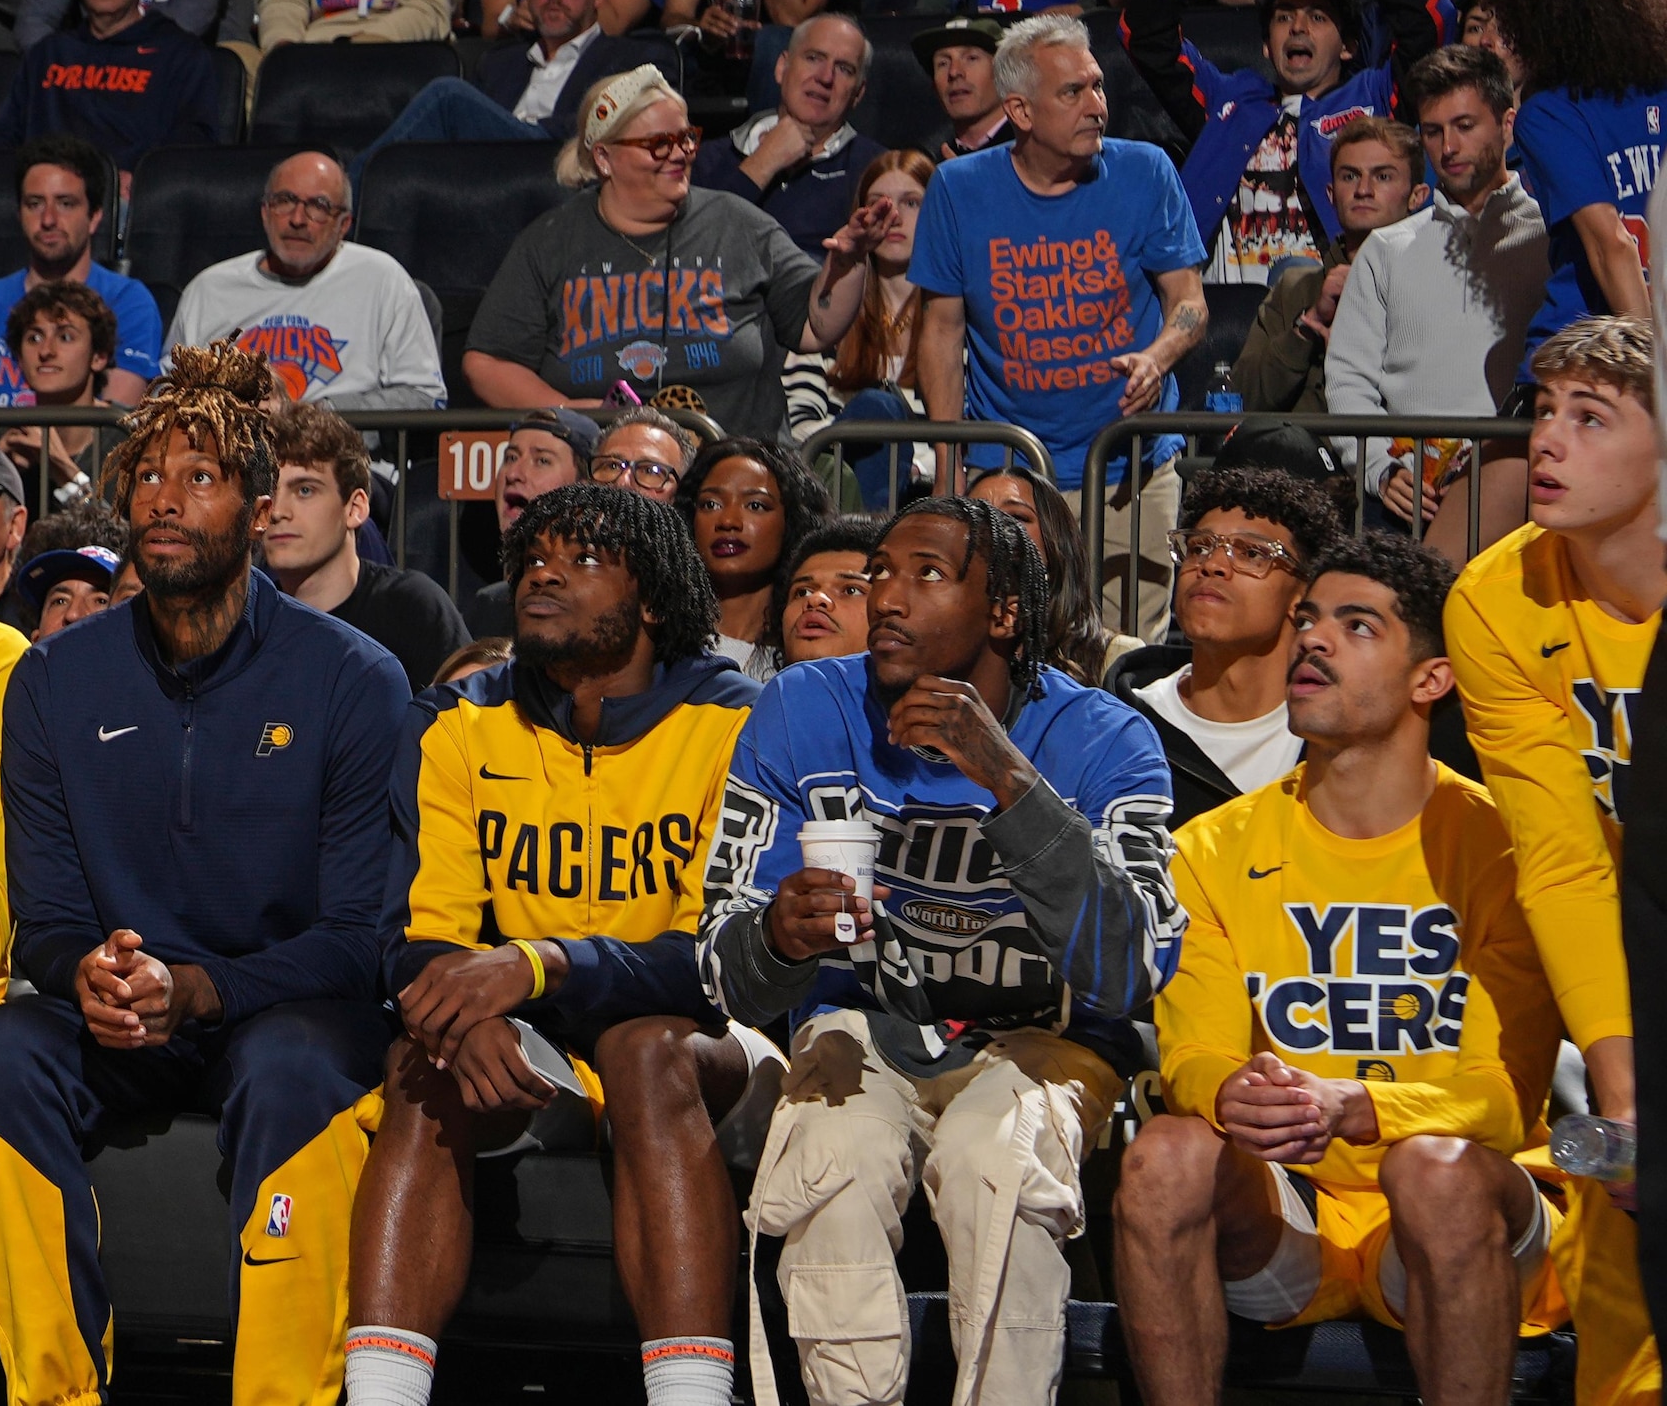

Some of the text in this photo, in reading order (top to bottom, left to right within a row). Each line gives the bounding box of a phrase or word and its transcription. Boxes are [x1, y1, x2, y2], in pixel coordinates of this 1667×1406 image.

[1607, 145, 1660, 201] EWI
[989, 230, 1119, 271] Ewing&
[990, 258, 1127, 302] Starks&
[559, 269, 731, 357] KNICKS
[993, 287, 1134, 334] Oakley&
[683, 342, 722, 371] 1946
[998, 316, 1135, 362] Mason&
[478, 809, 693, 903] PACERS
[904, 905, 967, 930] World
[1283, 902, 1461, 978] YES
